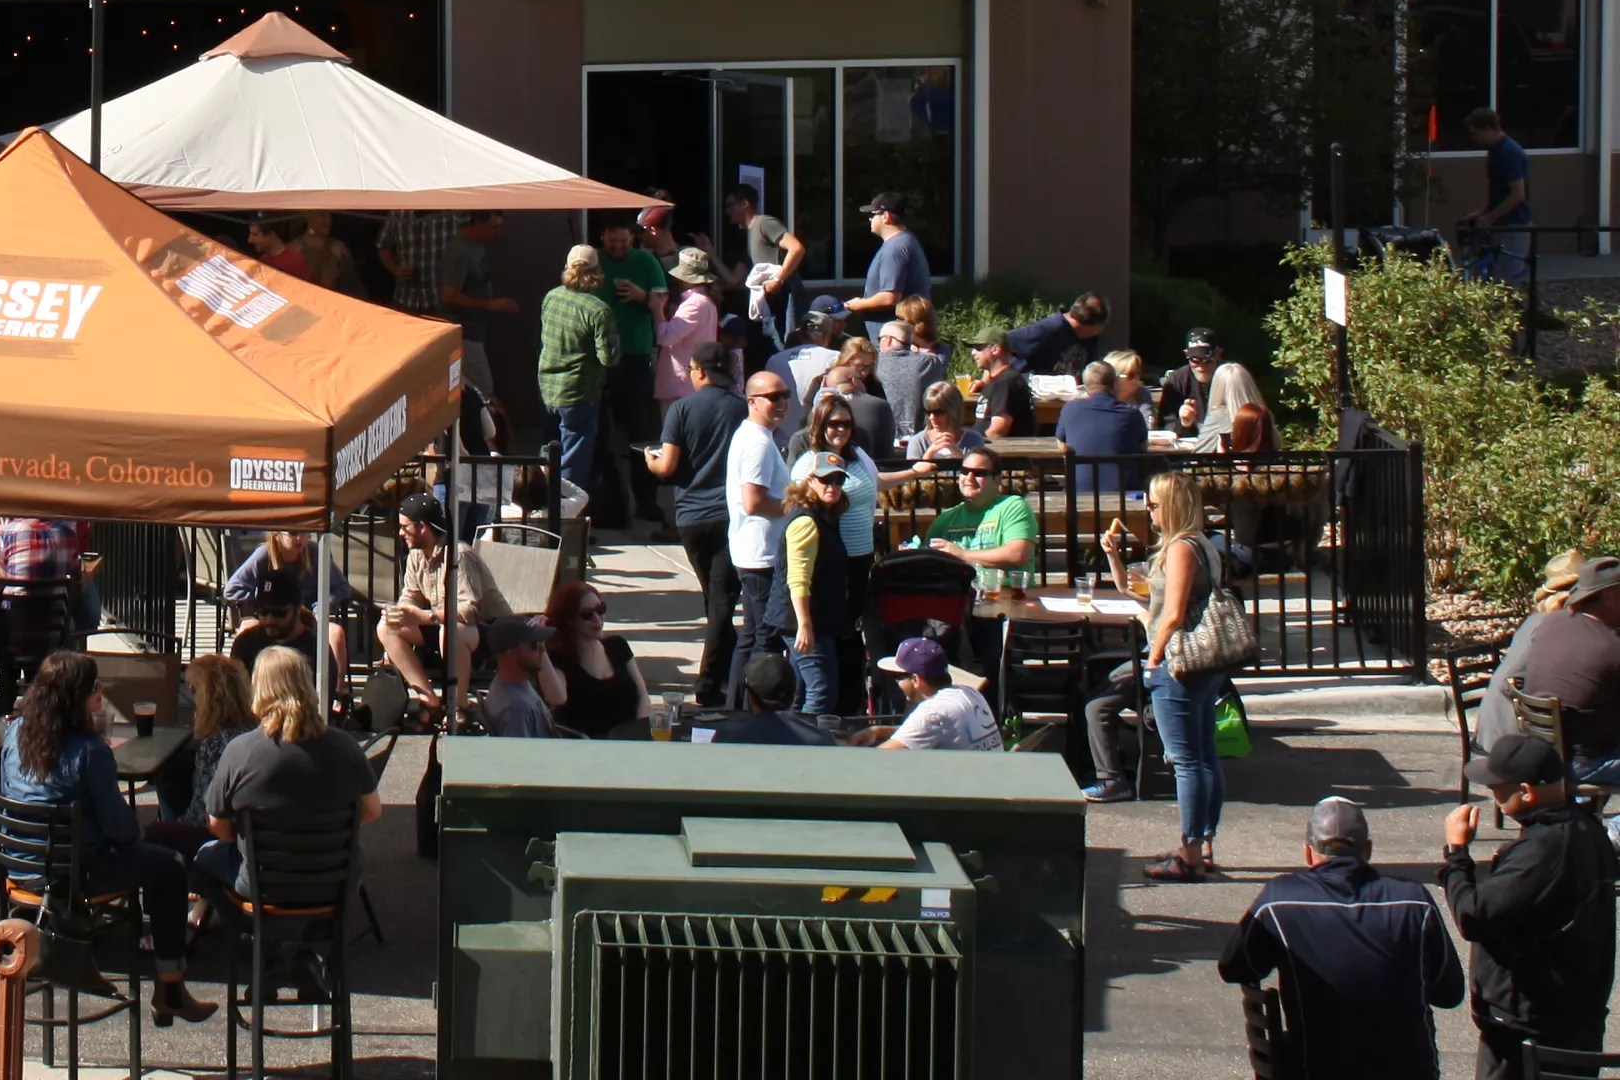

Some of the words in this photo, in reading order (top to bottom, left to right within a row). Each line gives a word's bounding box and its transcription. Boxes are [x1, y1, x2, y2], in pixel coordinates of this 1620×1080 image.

[85, 454, 214, 488] Colorado
[230, 458, 305, 492] ODYSSEY
[242, 480, 295, 492] BEERWERKS
